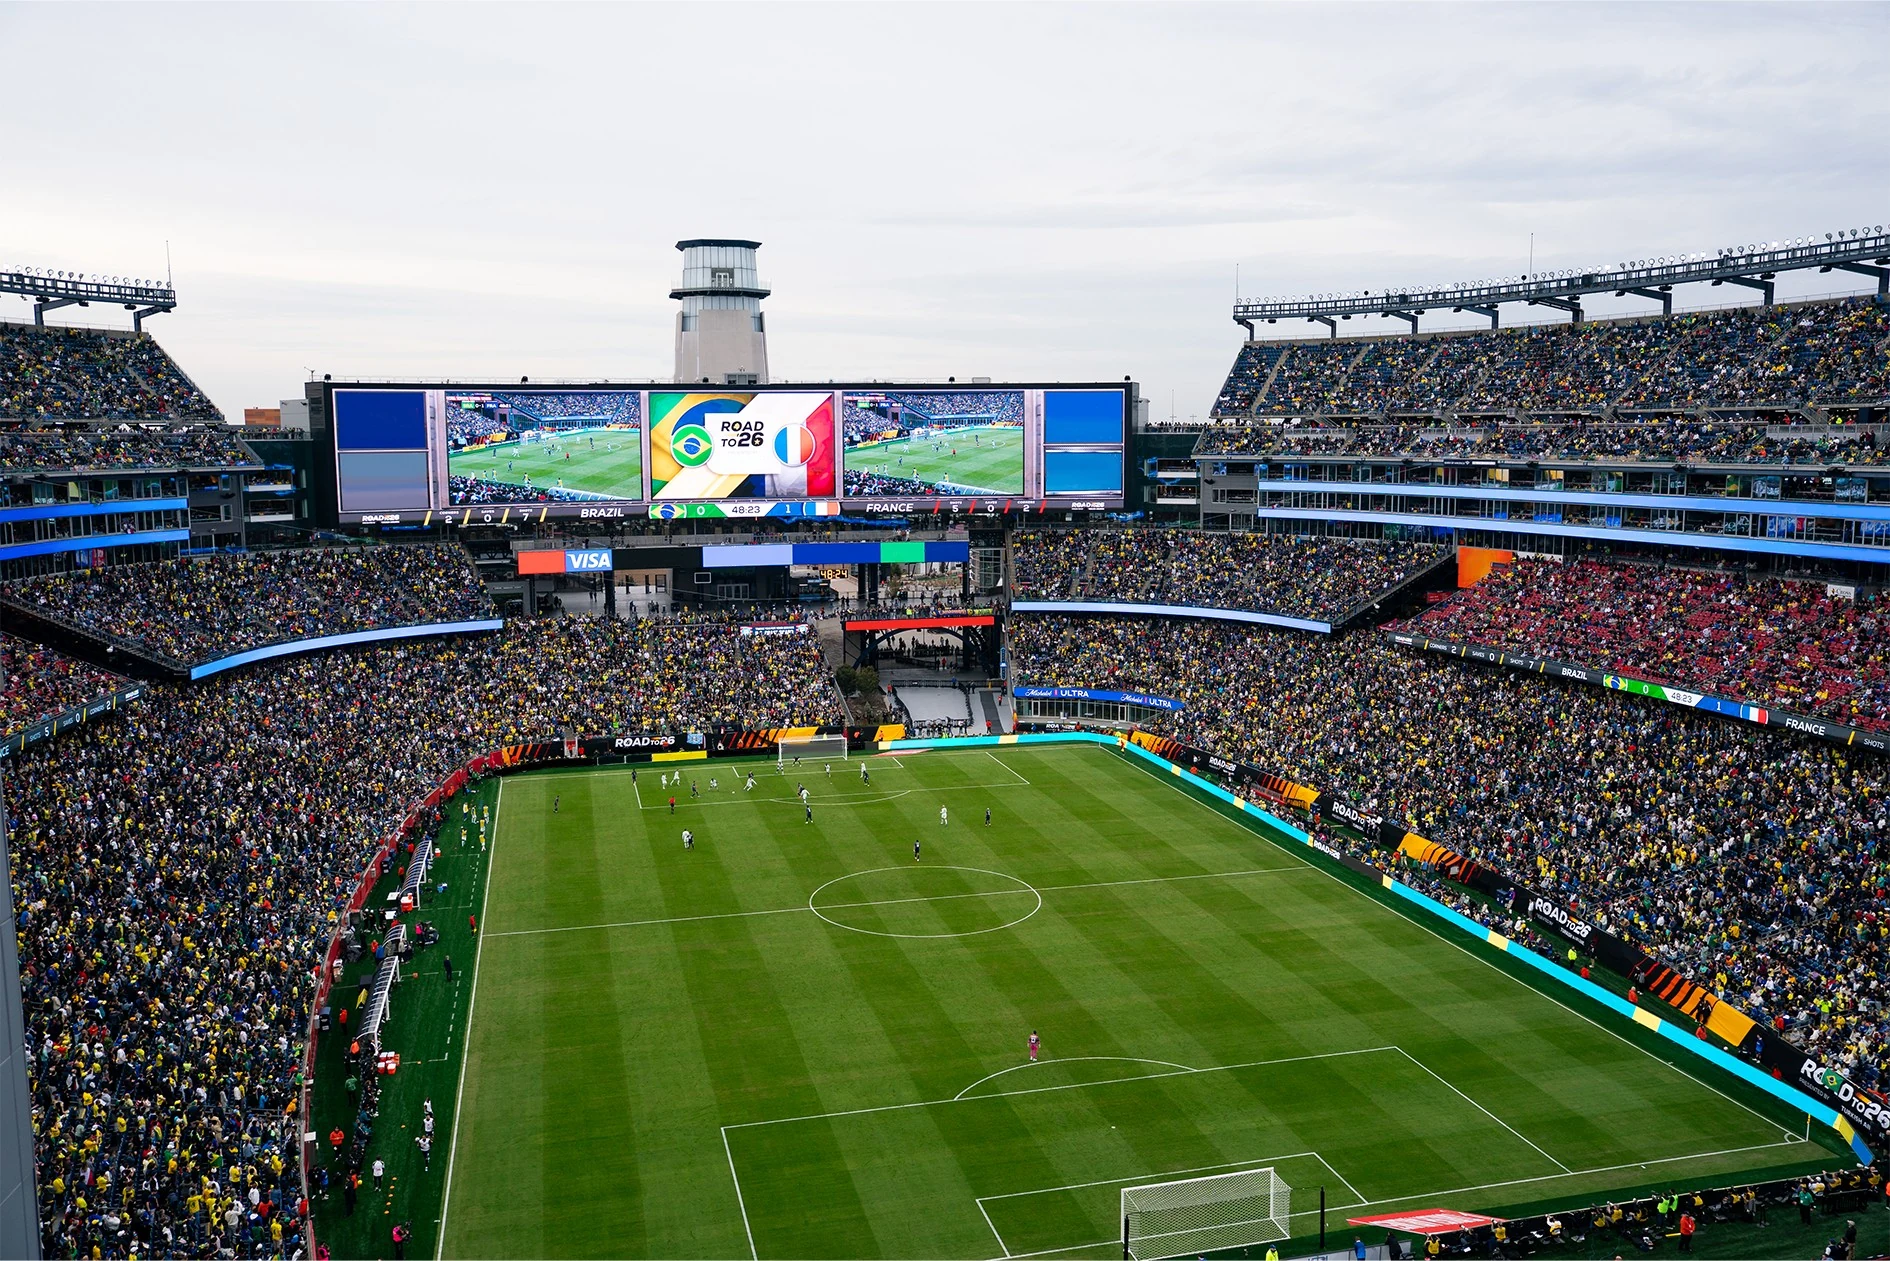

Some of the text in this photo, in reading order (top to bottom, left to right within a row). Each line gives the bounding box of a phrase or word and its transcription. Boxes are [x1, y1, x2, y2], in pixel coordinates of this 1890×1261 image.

[721, 421, 764, 432] ROAD
[721, 438, 737, 447] TO
[580, 508, 624, 518] BRAZIL
[697, 505, 791, 516] 0 48:23 1
[866, 503, 914, 512] FRANCE
[445, 515, 452, 523] 2
[484, 514, 492, 522] 0
[522, 513, 529, 521] 7
[566, 553, 611, 569] VISA
[820, 570, 847, 579] 48:24
[1429, 642, 1447, 650] CORNERS
[1489, 653, 1494, 661] 0
[1529, 661, 1534, 669] 7
[1562, 668, 1587, 680] BRAZIL
[1025, 688, 1089, 698] Michelob ULTRA
[1642, 685, 1721, 710] 0 48:23 1
[106, 701, 111, 710] 2
[1121, 693, 1172, 709] Michelob ULTRA
[90, 704, 105, 715] CORNERS
[63, 718, 73, 727] SAVES
[75, 713, 80, 723] 0
[30, 732, 41, 742] SHOTS
[45, 727, 49, 736] 5
[1786, 718, 1884, 749] FRANCE SHOTS
[615, 737, 650, 747] ROAD
[660, 736, 675, 745] 26
[1209, 756, 1226, 768] ROAD
[1229, 763, 1237, 771] 26
[1332, 802, 1358, 820] ROAD
[1314, 840, 1330, 853] ROAD
[1535, 898, 1568, 924] ROAD
[1566, 920, 1575, 930] TO
[1573, 920, 1592, 938] 26
[1799, 1077, 1823, 1096] PRESENTED
[1800, 1058, 1890, 1128] ROD TO 26
[1841, 1105, 1862, 1124] TURKISH
